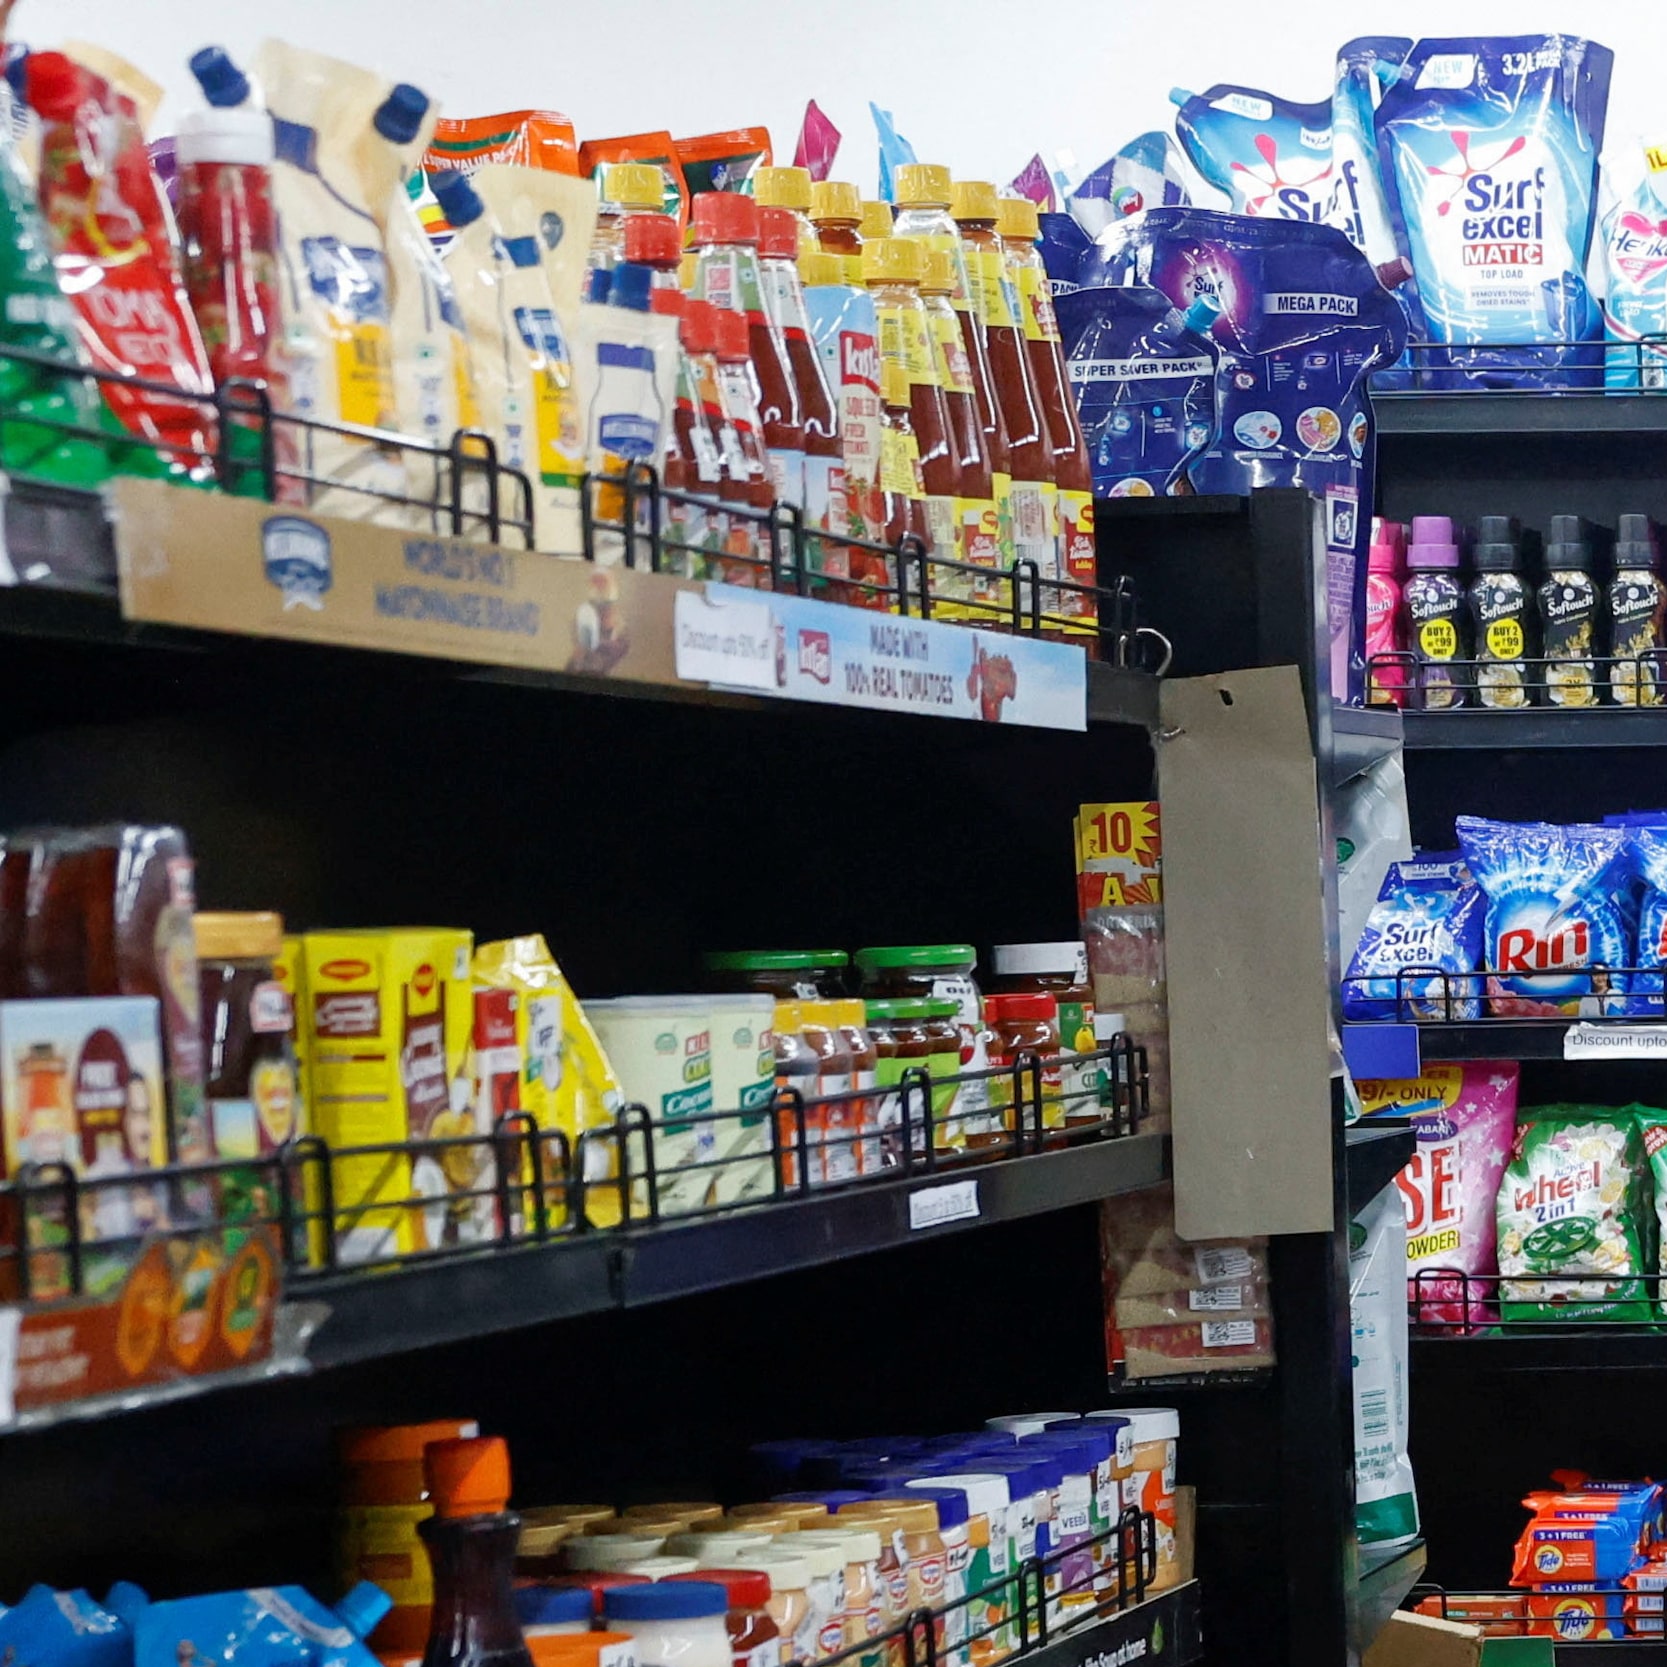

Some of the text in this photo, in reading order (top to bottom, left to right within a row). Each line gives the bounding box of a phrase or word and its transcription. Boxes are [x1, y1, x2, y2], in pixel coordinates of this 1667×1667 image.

[1465, 168, 1544, 213] Surf
[1463, 212, 1542, 240] excel
[1464, 246, 1542, 264] MATIC
[1277, 296, 1355, 316] MEGA PACK
[1075, 361, 1125, 377] SUPER
[1162, 361, 1197, 375] PACK
[1411, 599, 1458, 620] Softouch
[1480, 598, 1523, 620] Softouch
[1548, 596, 1594, 617] Softouch
[1612, 596, 1658, 617] Softouch
[1427, 627, 1451, 637] BUY 2
[1493, 627, 1519, 637] BUY 2
[1384, 922, 1438, 946] Surf
[1499, 920, 1588, 976] Rin
[1573, 1033, 1635, 1050] Discount
[1401, 1085, 1448, 1101] ONLY
[1537, 1550, 1563, 1571] Tide
